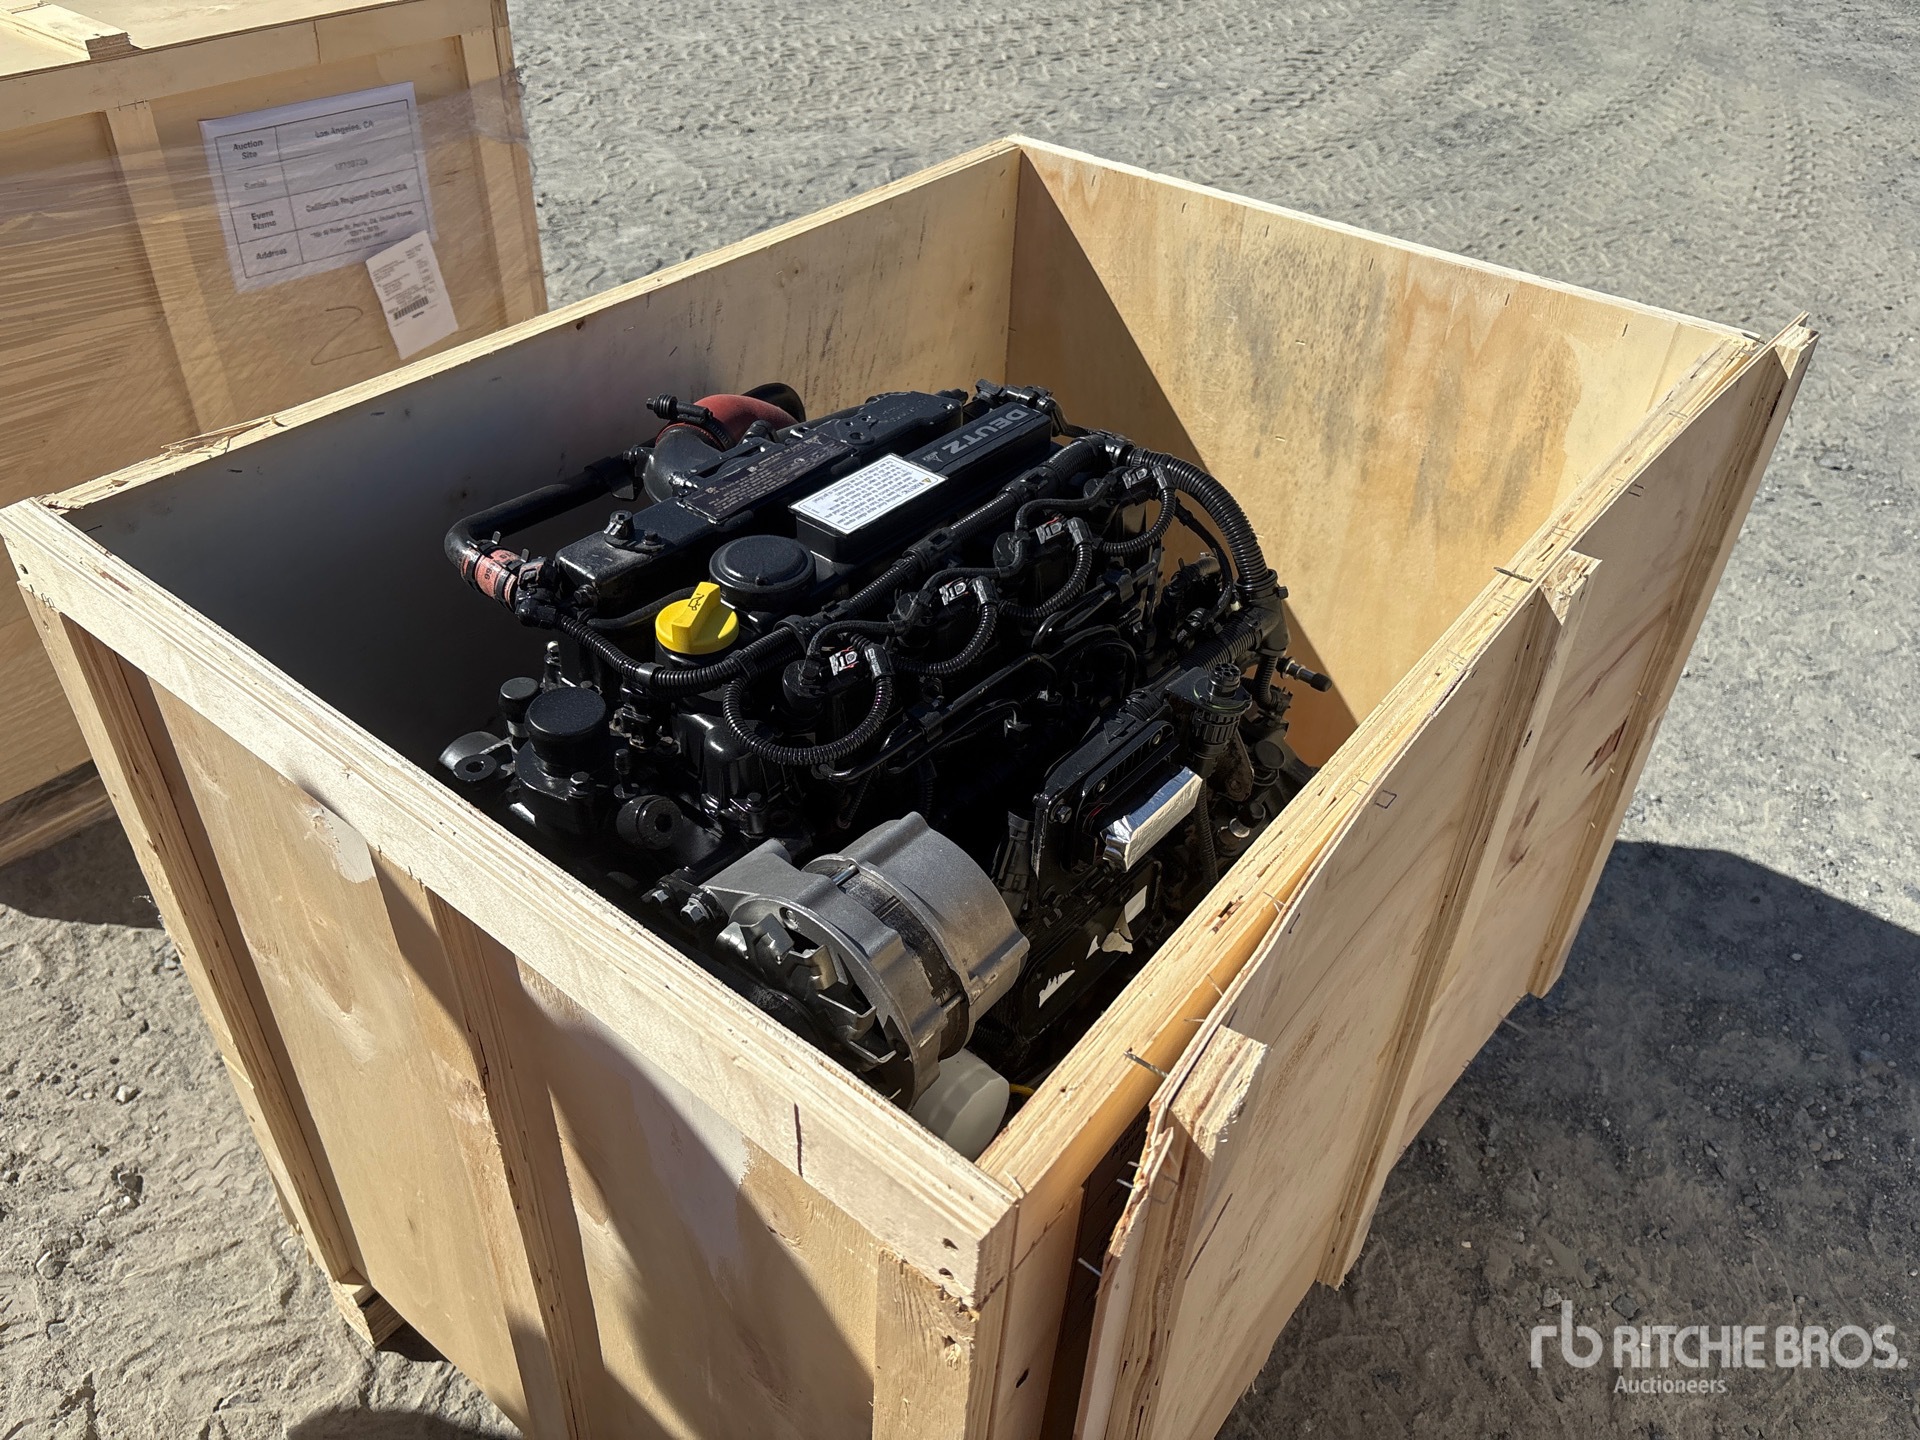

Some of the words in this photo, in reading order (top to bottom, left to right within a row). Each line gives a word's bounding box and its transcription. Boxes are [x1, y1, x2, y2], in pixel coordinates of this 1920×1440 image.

[363, 120, 374, 129] CA
[233, 139, 264, 151] Auction
[241, 151, 258, 160] Site
[251, 210, 274, 221] Event
[253, 220, 277, 230] Name
[256, 248, 287, 260] Address
[941, 408, 1029, 455] DEUTZ
